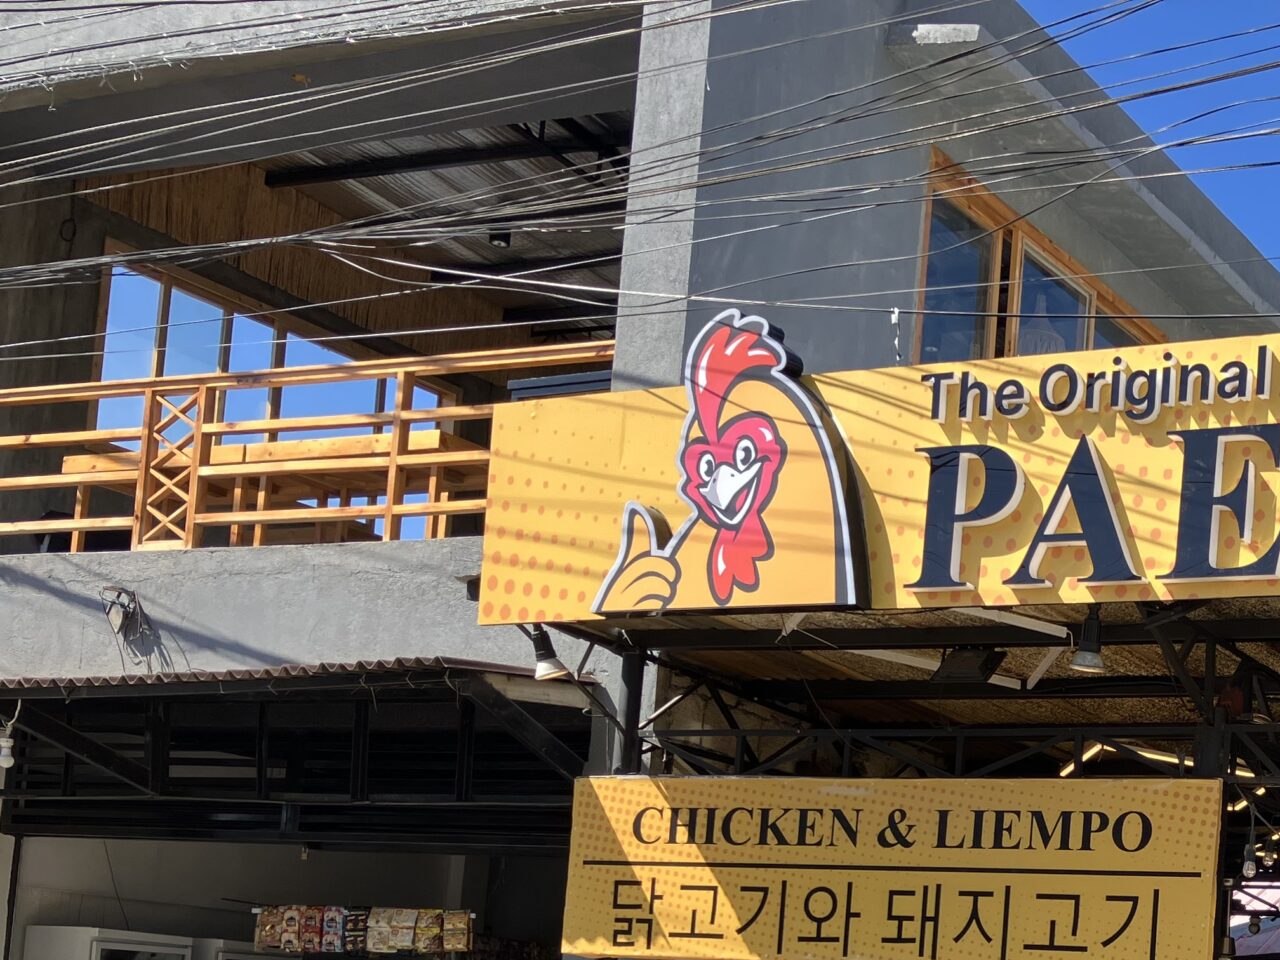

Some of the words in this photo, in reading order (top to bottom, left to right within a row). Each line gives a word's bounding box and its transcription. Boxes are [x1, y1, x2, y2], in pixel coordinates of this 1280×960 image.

[921, 371, 1030, 423] The
[1038, 344, 1273, 424] Original
[632, 806, 862, 849] CHICKEN
[877, 808, 916, 849] &
[933, 808, 1154, 854] LIEMPO
[612, 876, 862, 957] 닭고기와
